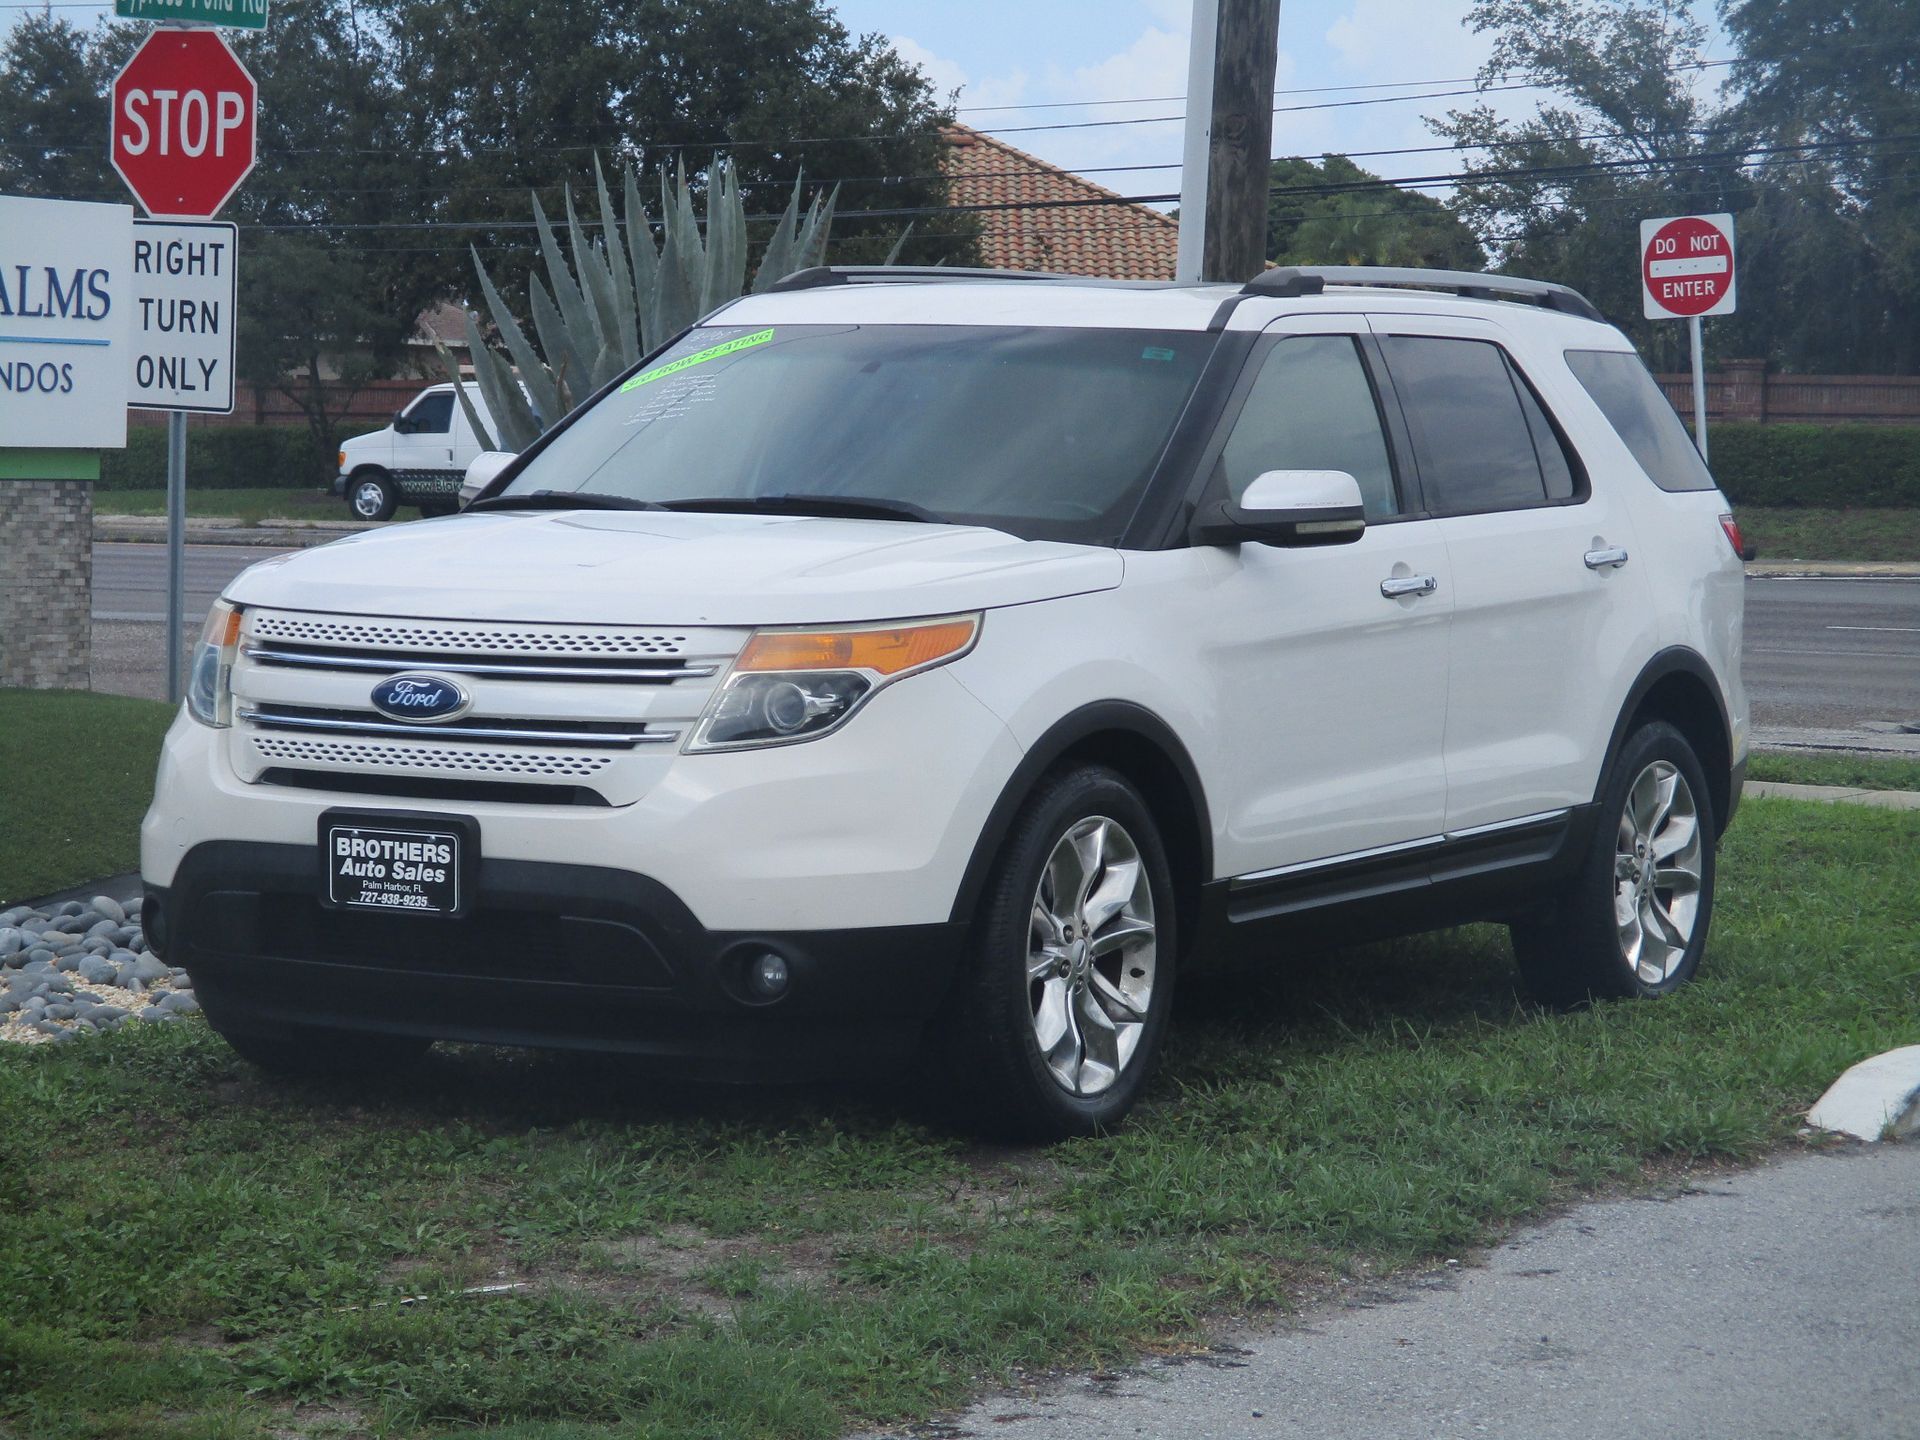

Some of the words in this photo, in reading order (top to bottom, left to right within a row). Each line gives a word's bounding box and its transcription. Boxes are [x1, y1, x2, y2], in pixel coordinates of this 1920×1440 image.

[122, 88, 245, 158] STOP
[1655, 238, 1677, 255] DO
[1690, 234, 1720, 252] NOT
[134, 240, 225, 277] RIGHT
[1663, 280, 1715, 299] ENTER
[139, 298, 219, 335] TURN
[136, 355, 218, 392] ONLY
[388, 680, 443, 708] Ford
[336, 837, 451, 864] BROTHERS
[339, 857, 386, 878] Auto
[391, 861, 446, 883] Sales
[359, 891, 428, 908] 727-938-9235
[362, 880, 382, 890] Palm
[383, 882, 412, 894] Harbor,
[413, 884, 424, 893] FL
